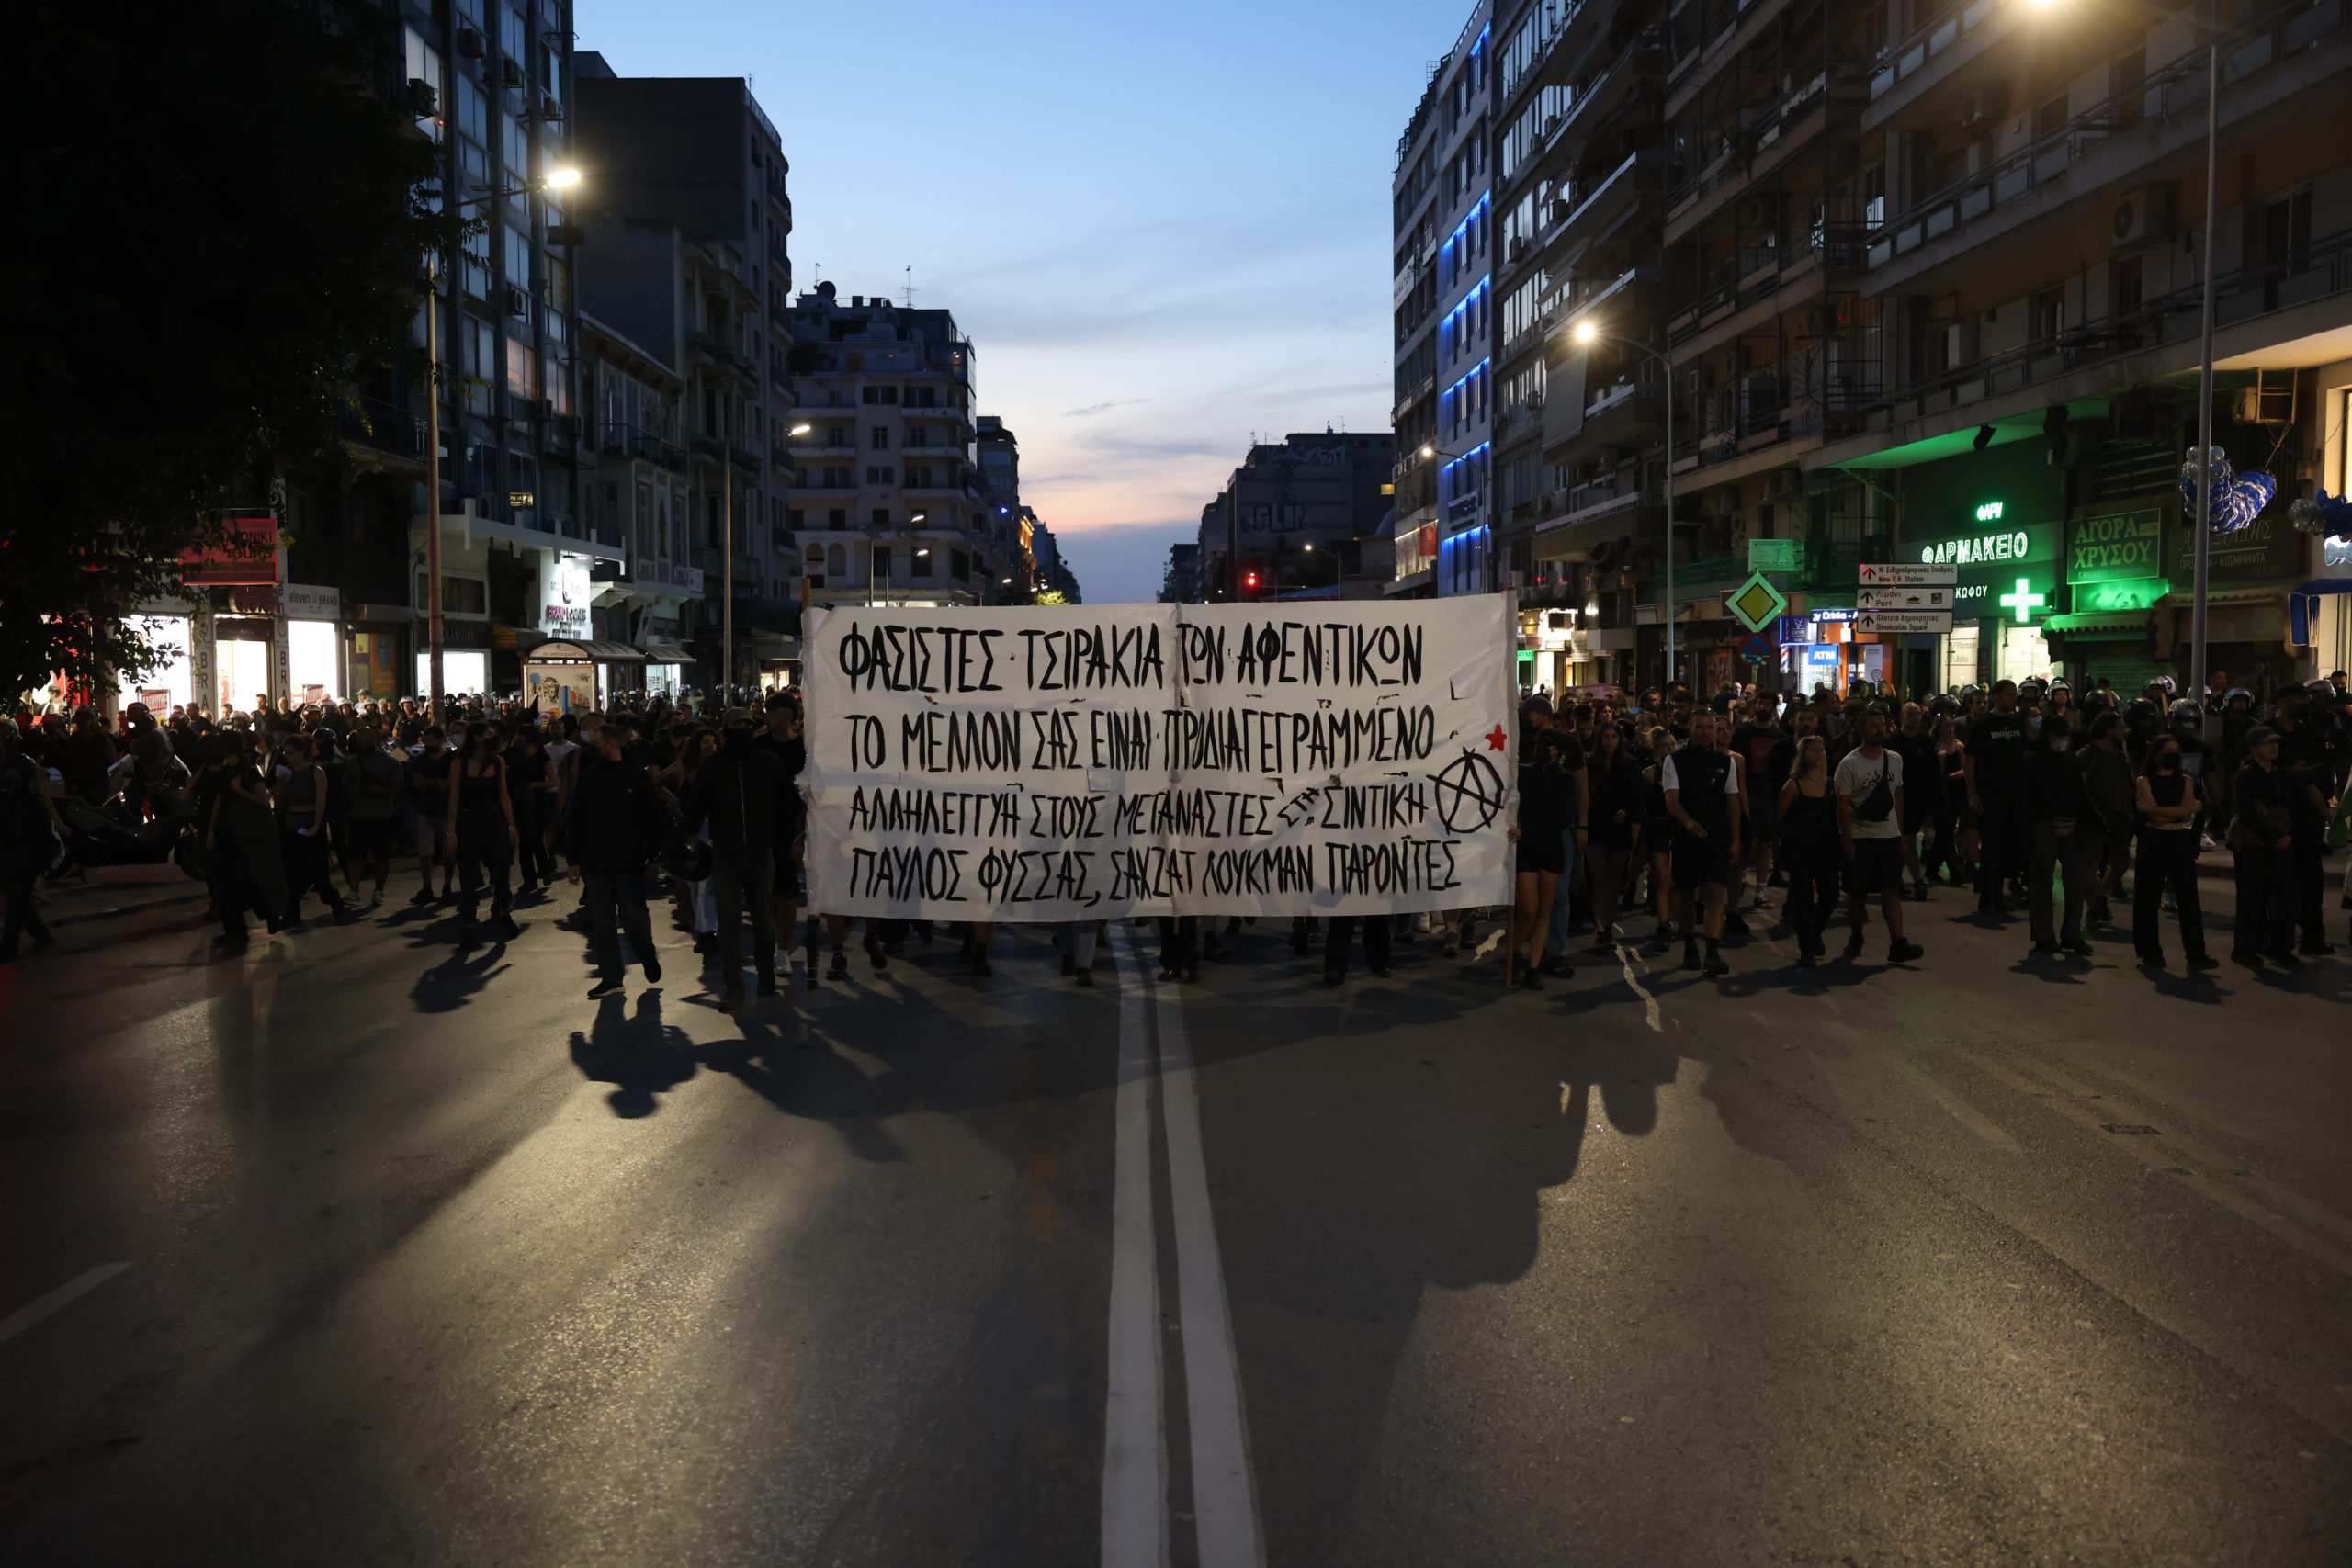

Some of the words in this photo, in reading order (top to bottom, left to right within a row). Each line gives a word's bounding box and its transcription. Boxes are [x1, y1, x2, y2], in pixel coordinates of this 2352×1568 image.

[2075, 515, 2139, 544] ΑΓΟΡΑ
[1921, 532, 2029, 564] ΦΑΡΜΑΚΕΙΟ
[2074, 539, 2152, 569] ΧΡΥΣΟΥ
[2220, 553, 2266, 566] ΚΟΣΜΗΜΑΤΑ
[1822, 611, 1847, 620] Drinks
[839, 622, 1004, 694] ΦΑΣΙΣΤΕΣ
[1017, 623, 1164, 690] ΤΣΙΡΑΚΙΑ
[1176, 623, 1226, 686] ΤΩΝ
[1237, 621, 1422, 687] ΑΦΕΝΤΙΚΩΝ
[1814, 651, 1836, 660] ATM
[844, 715, 886, 772] ΤΟ
[902, 710, 1021, 772] ΜΕΛΛΟΝ
[1030, 707, 1083, 771] ΣΑΣ
[1091, 709, 1151, 771] ΕΙΝΑΙ
[1162, 705, 1434, 774] ΠΡΟΔΙΑΓΕΓΡΑΜΜΕΝΟ
[849, 785, 1022, 838] ΑΛΛΗΛΕΓΓΥΗ
[1030, 794, 1106, 840] ΣΤΟΥΣ
[1114, 788, 1276, 839] ΜΕΤΑΝΑΣΤΕΣ
[1321, 783, 1429, 830] ΣΙΝΤΙΚΗ
[849, 845, 969, 902] ΠΑΥΛΟΣ
[1109, 846, 1196, 901] ΣΑΧΖΑΤ
[1202, 843, 1314, 897] ΛΟΥΚΜΑΝ
[1325, 840, 1463, 897] ΠΑΡΟΝΤΕΣ
